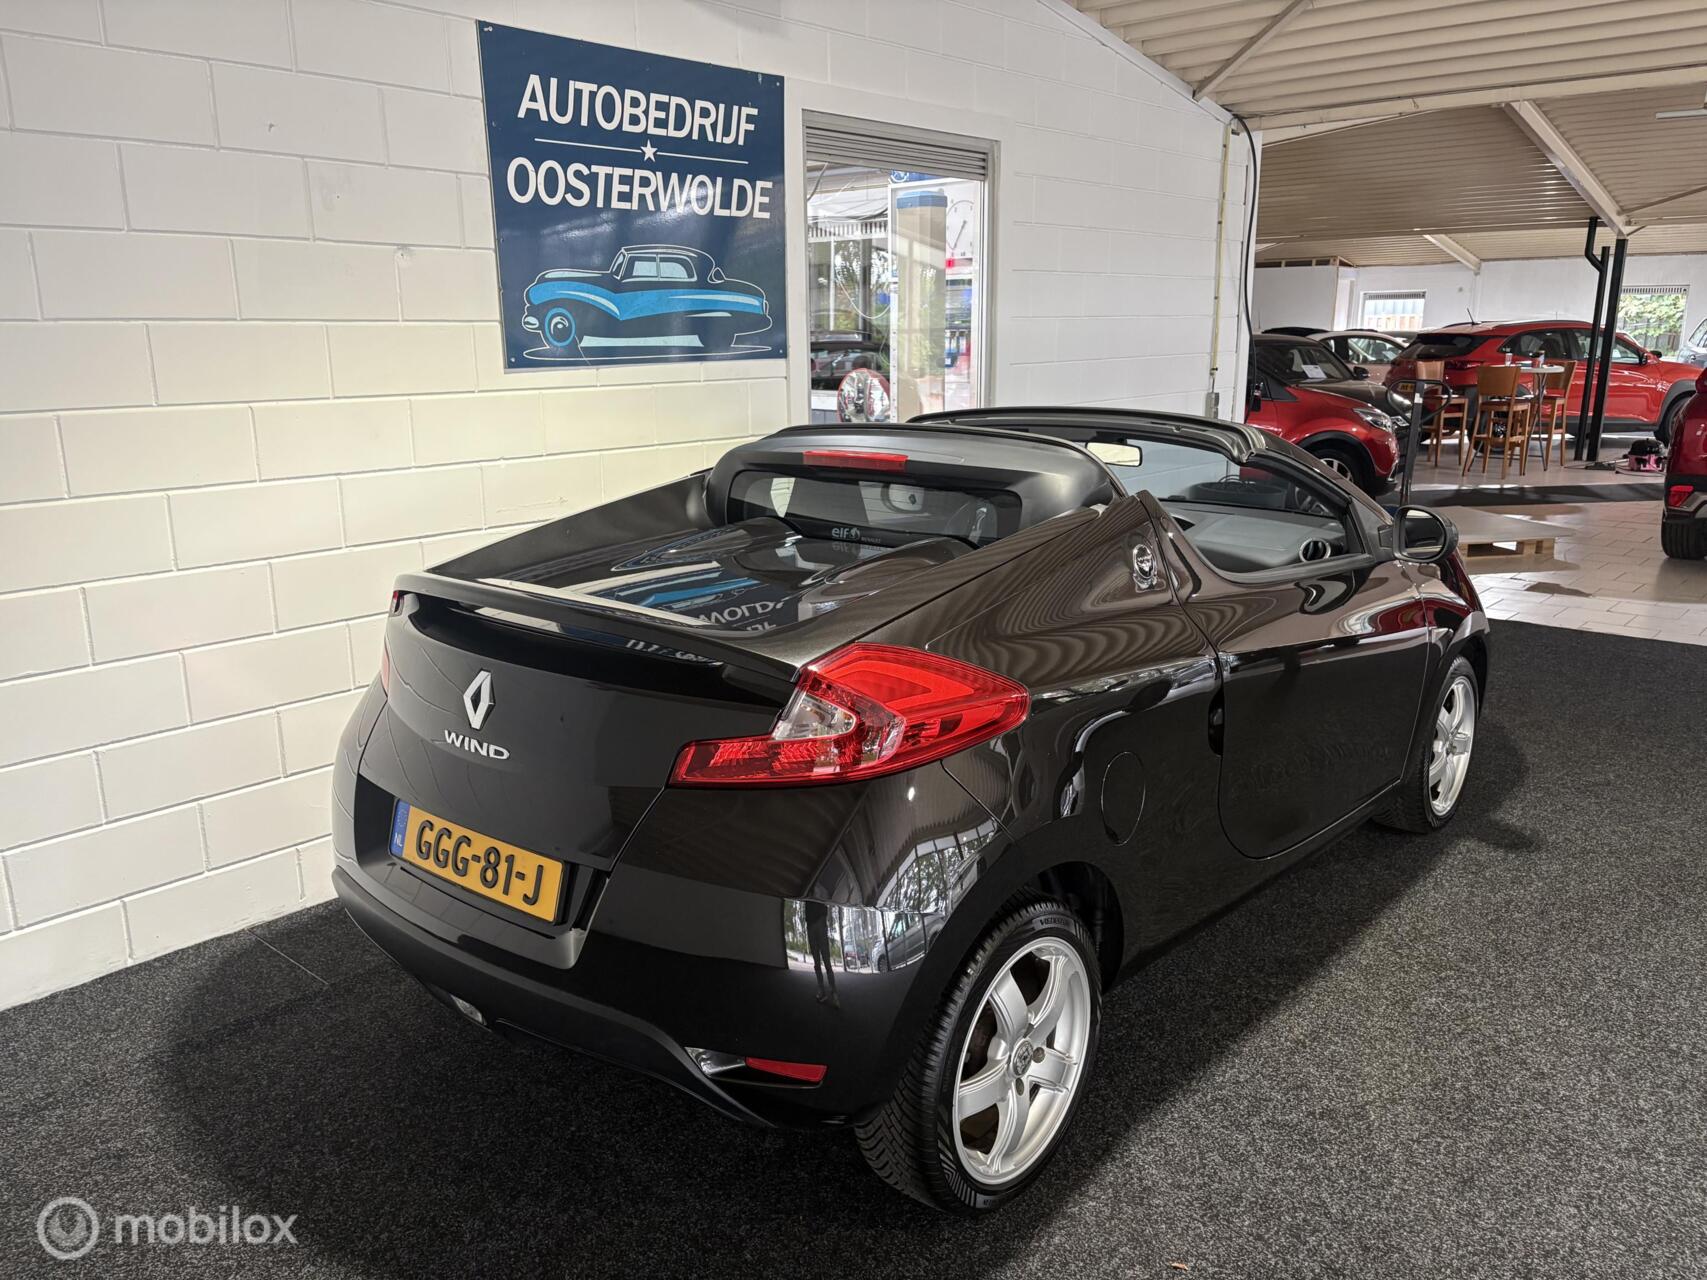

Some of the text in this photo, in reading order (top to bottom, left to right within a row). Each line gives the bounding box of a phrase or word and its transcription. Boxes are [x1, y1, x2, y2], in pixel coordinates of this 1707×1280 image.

[517, 74, 759, 146] AUTOBEDRIJF
[507, 156, 773, 219] OOSTERWOLDE
[831, 527, 850, 538] elf
[444, 729, 511, 760] WIND
[415, 819, 544, 906] GGG-81-J
